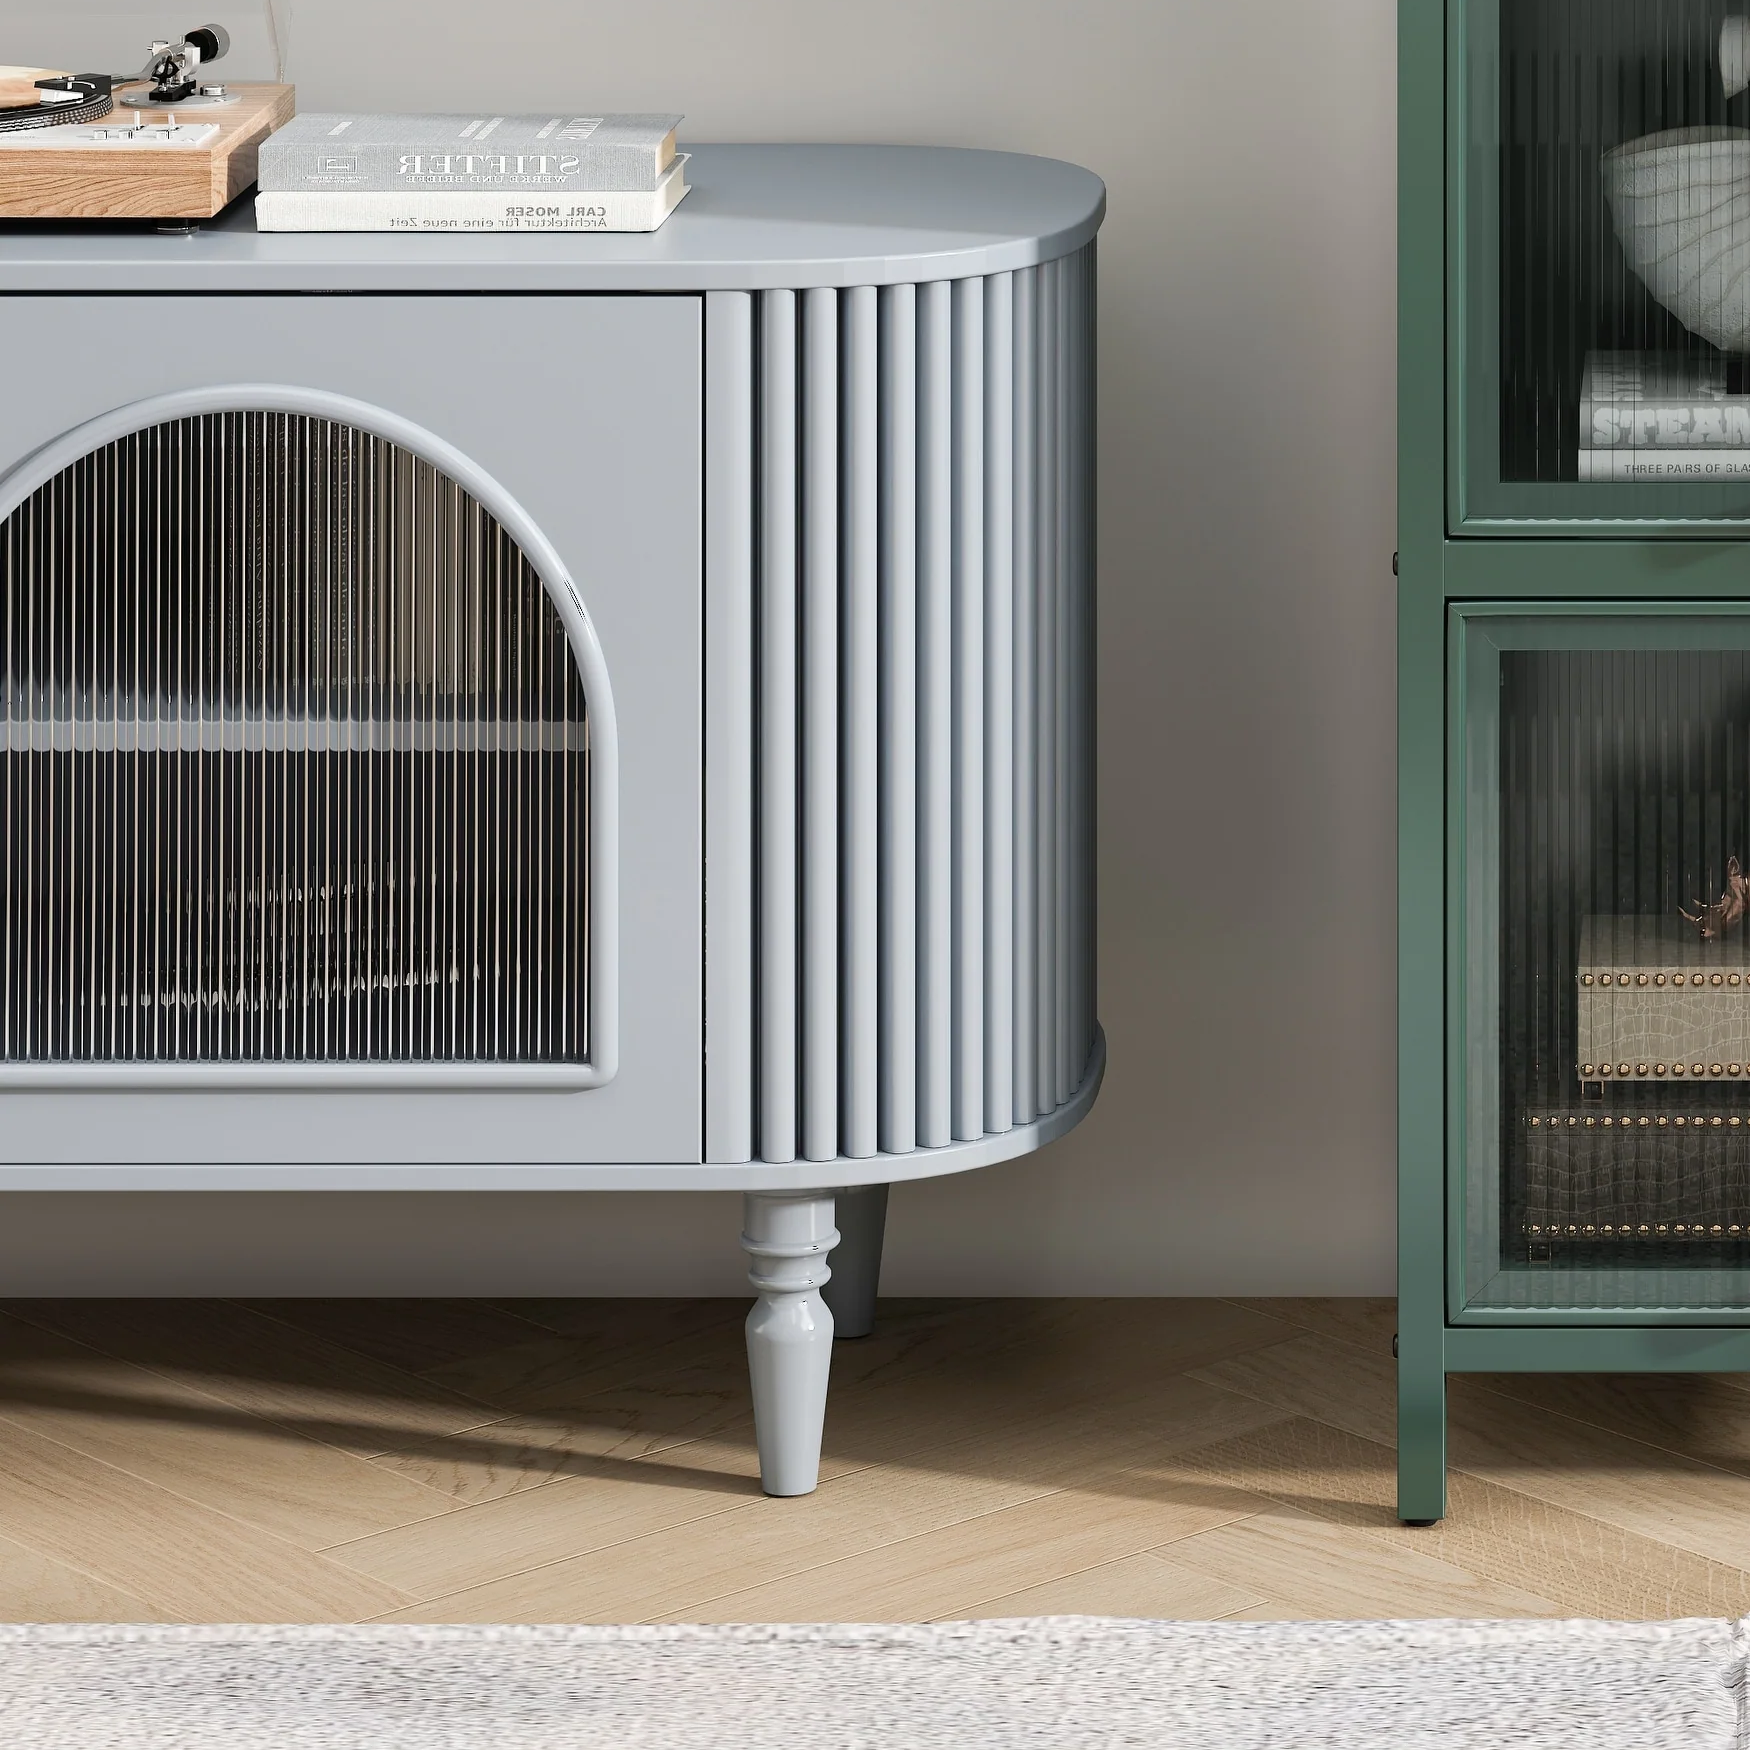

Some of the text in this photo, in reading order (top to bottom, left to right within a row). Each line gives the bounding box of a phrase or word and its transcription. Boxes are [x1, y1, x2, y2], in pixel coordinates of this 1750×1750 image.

[1624, 464, 1663, 474] THREE
[1667, 464, 1701, 474] PAIRS
[1705, 463, 1721, 473] OF
